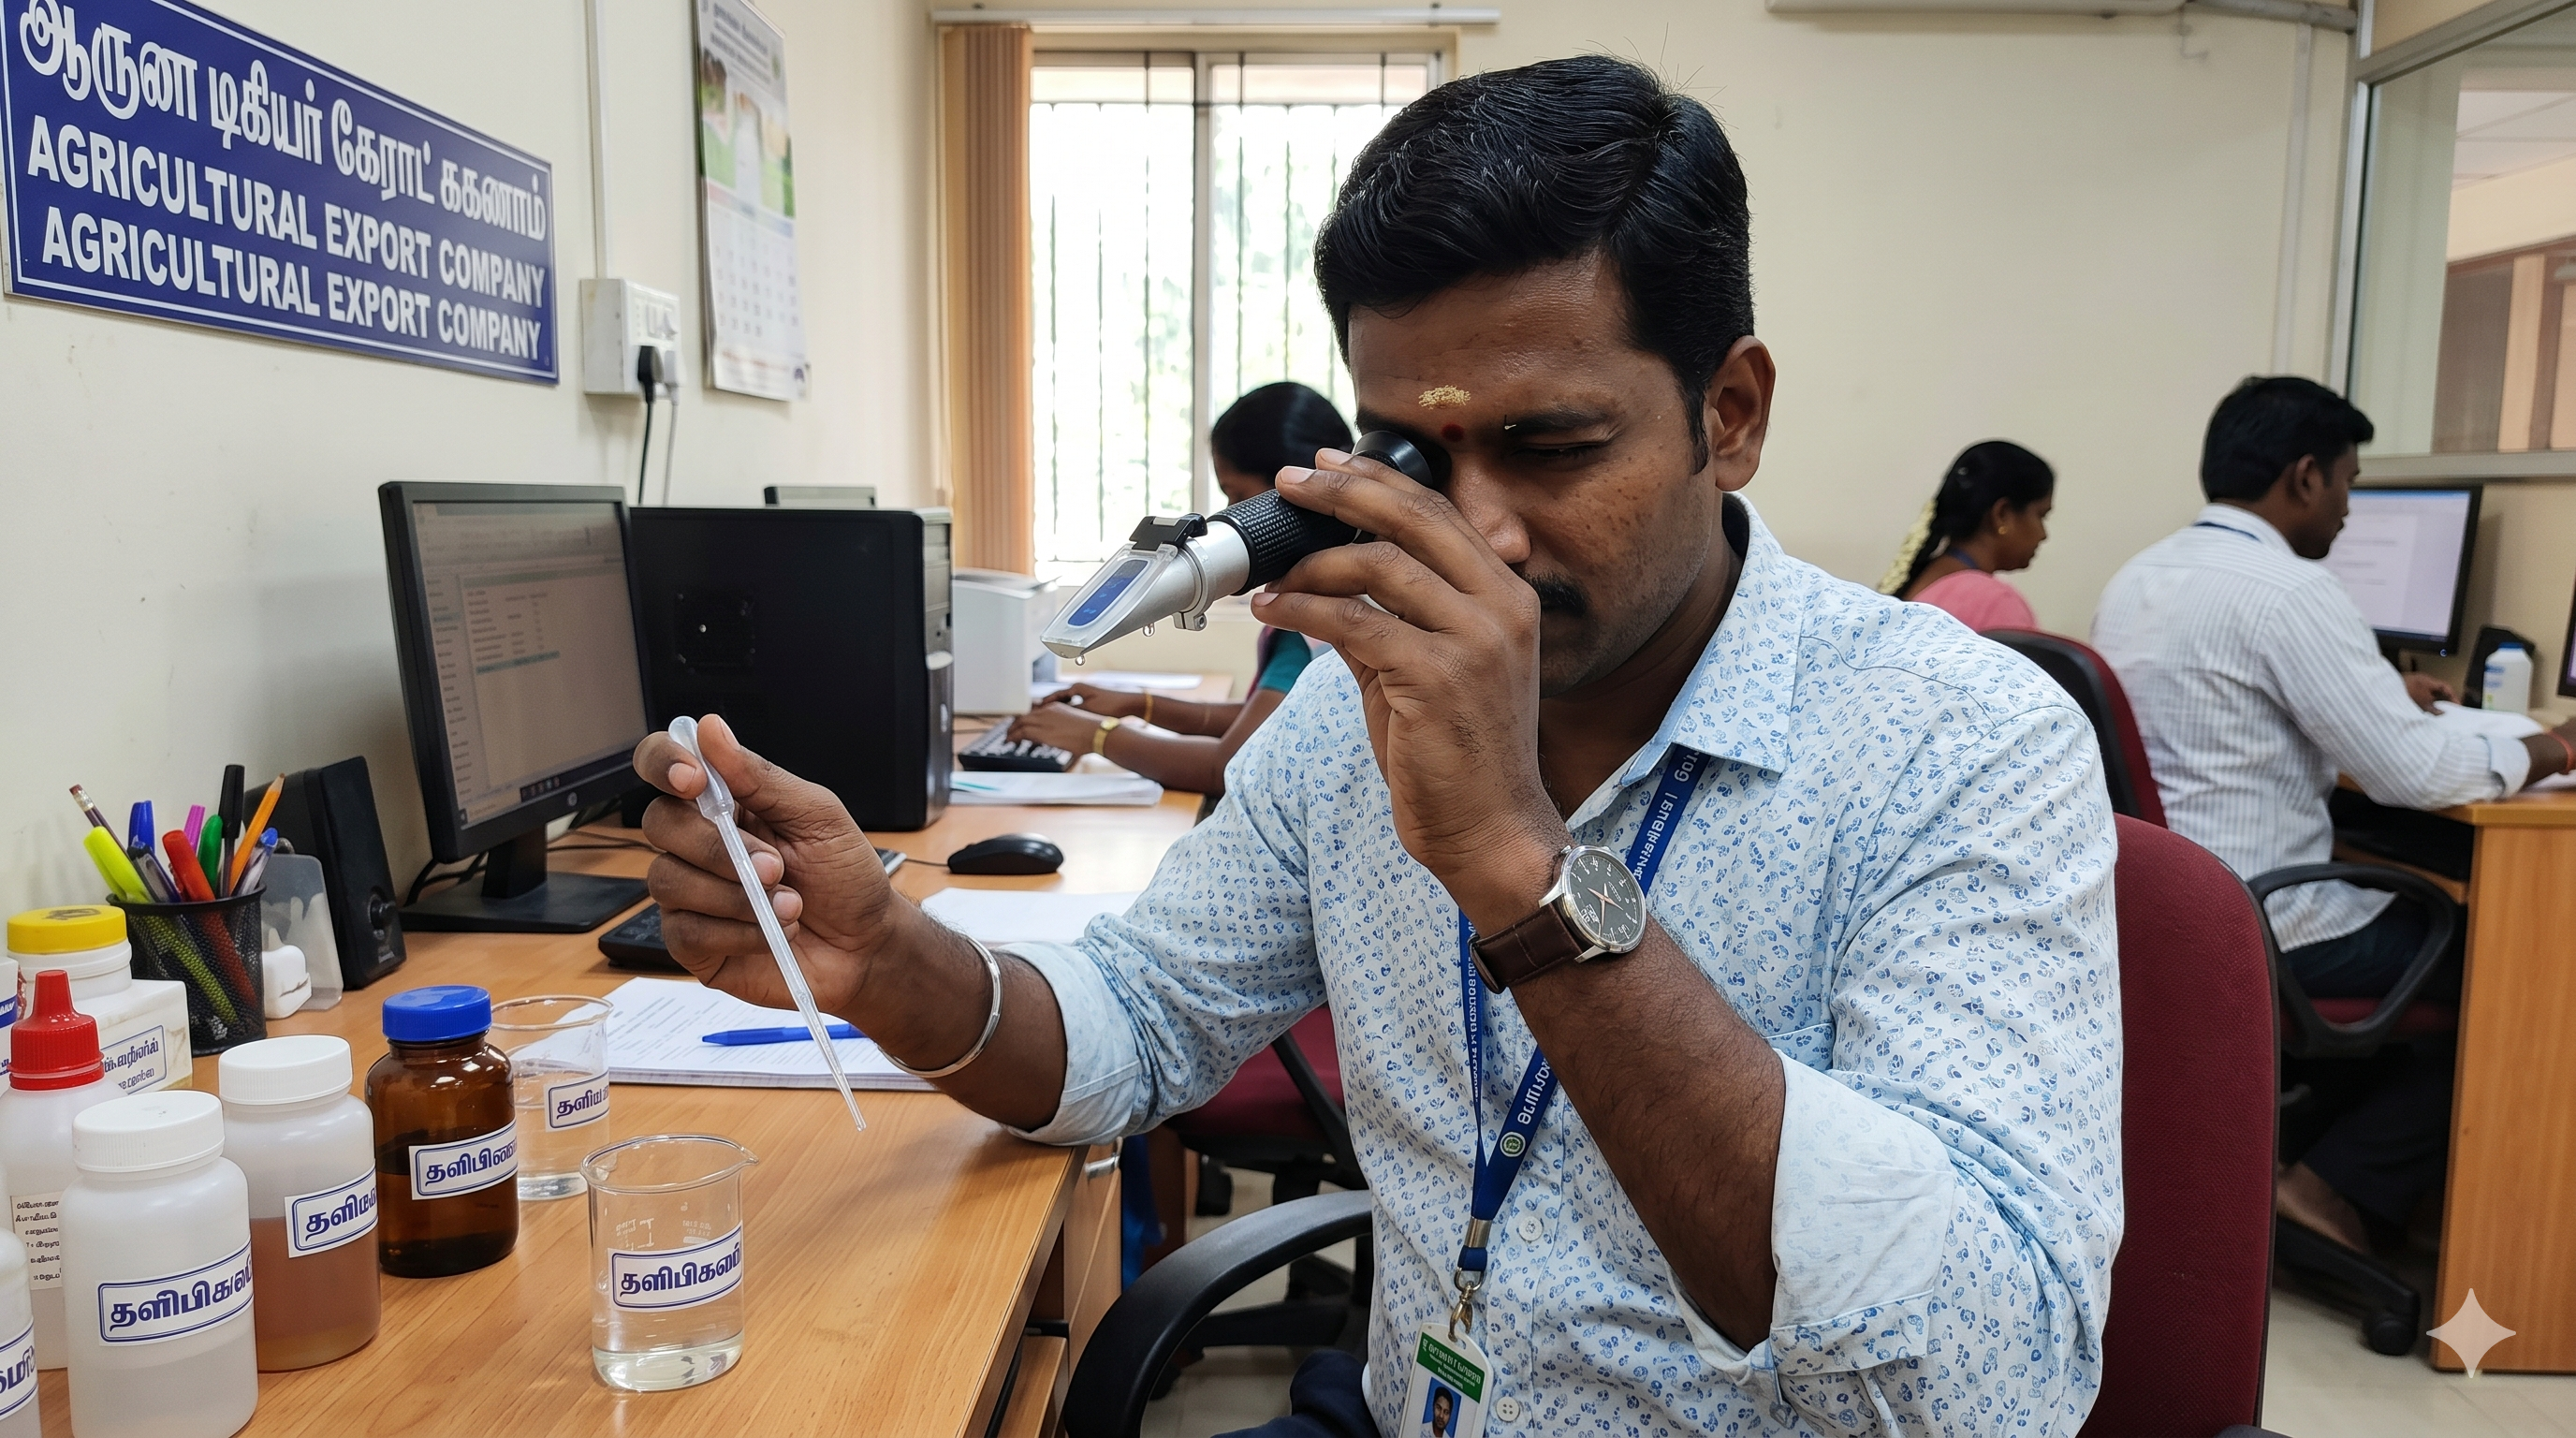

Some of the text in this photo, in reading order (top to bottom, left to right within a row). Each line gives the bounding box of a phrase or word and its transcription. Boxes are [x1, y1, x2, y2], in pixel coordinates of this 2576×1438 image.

[27, 114, 545, 307] AGRICULTURAL EXPORT COMPANY
[42, 205, 541, 360] AGRICULTURAL EXPORT COMPANY
